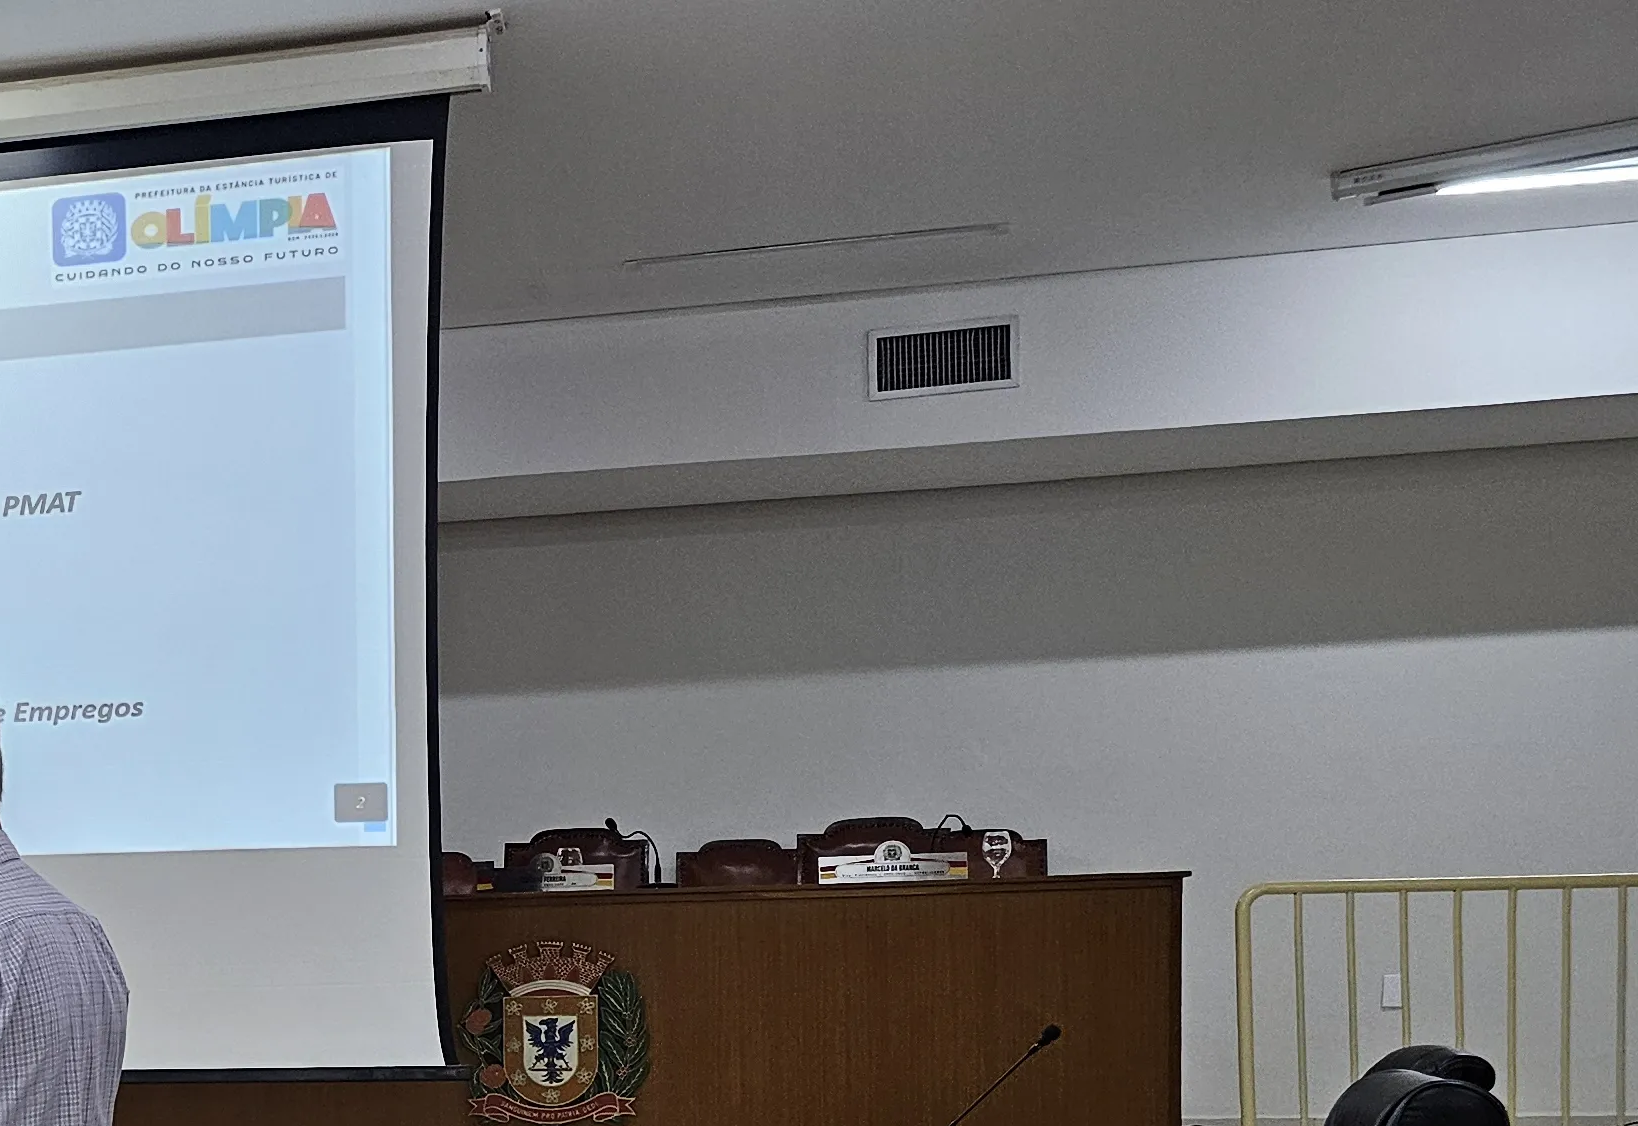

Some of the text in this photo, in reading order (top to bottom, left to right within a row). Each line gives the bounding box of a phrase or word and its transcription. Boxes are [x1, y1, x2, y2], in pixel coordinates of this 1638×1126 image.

[134, 171, 338, 200] PREFEITURA DA ESTÂNCIA TURÍSTICA DE
[130, 192, 338, 250] OLÍMPIA
[55, 246, 339, 283] CUIDANDO DO NOSSO FUTURO
[2, 490, 82, 517] PMAT
[13, 701, 145, 727] Empregos
[355, 795, 367, 809] 2
[540, 1112, 555, 1120] PRO
